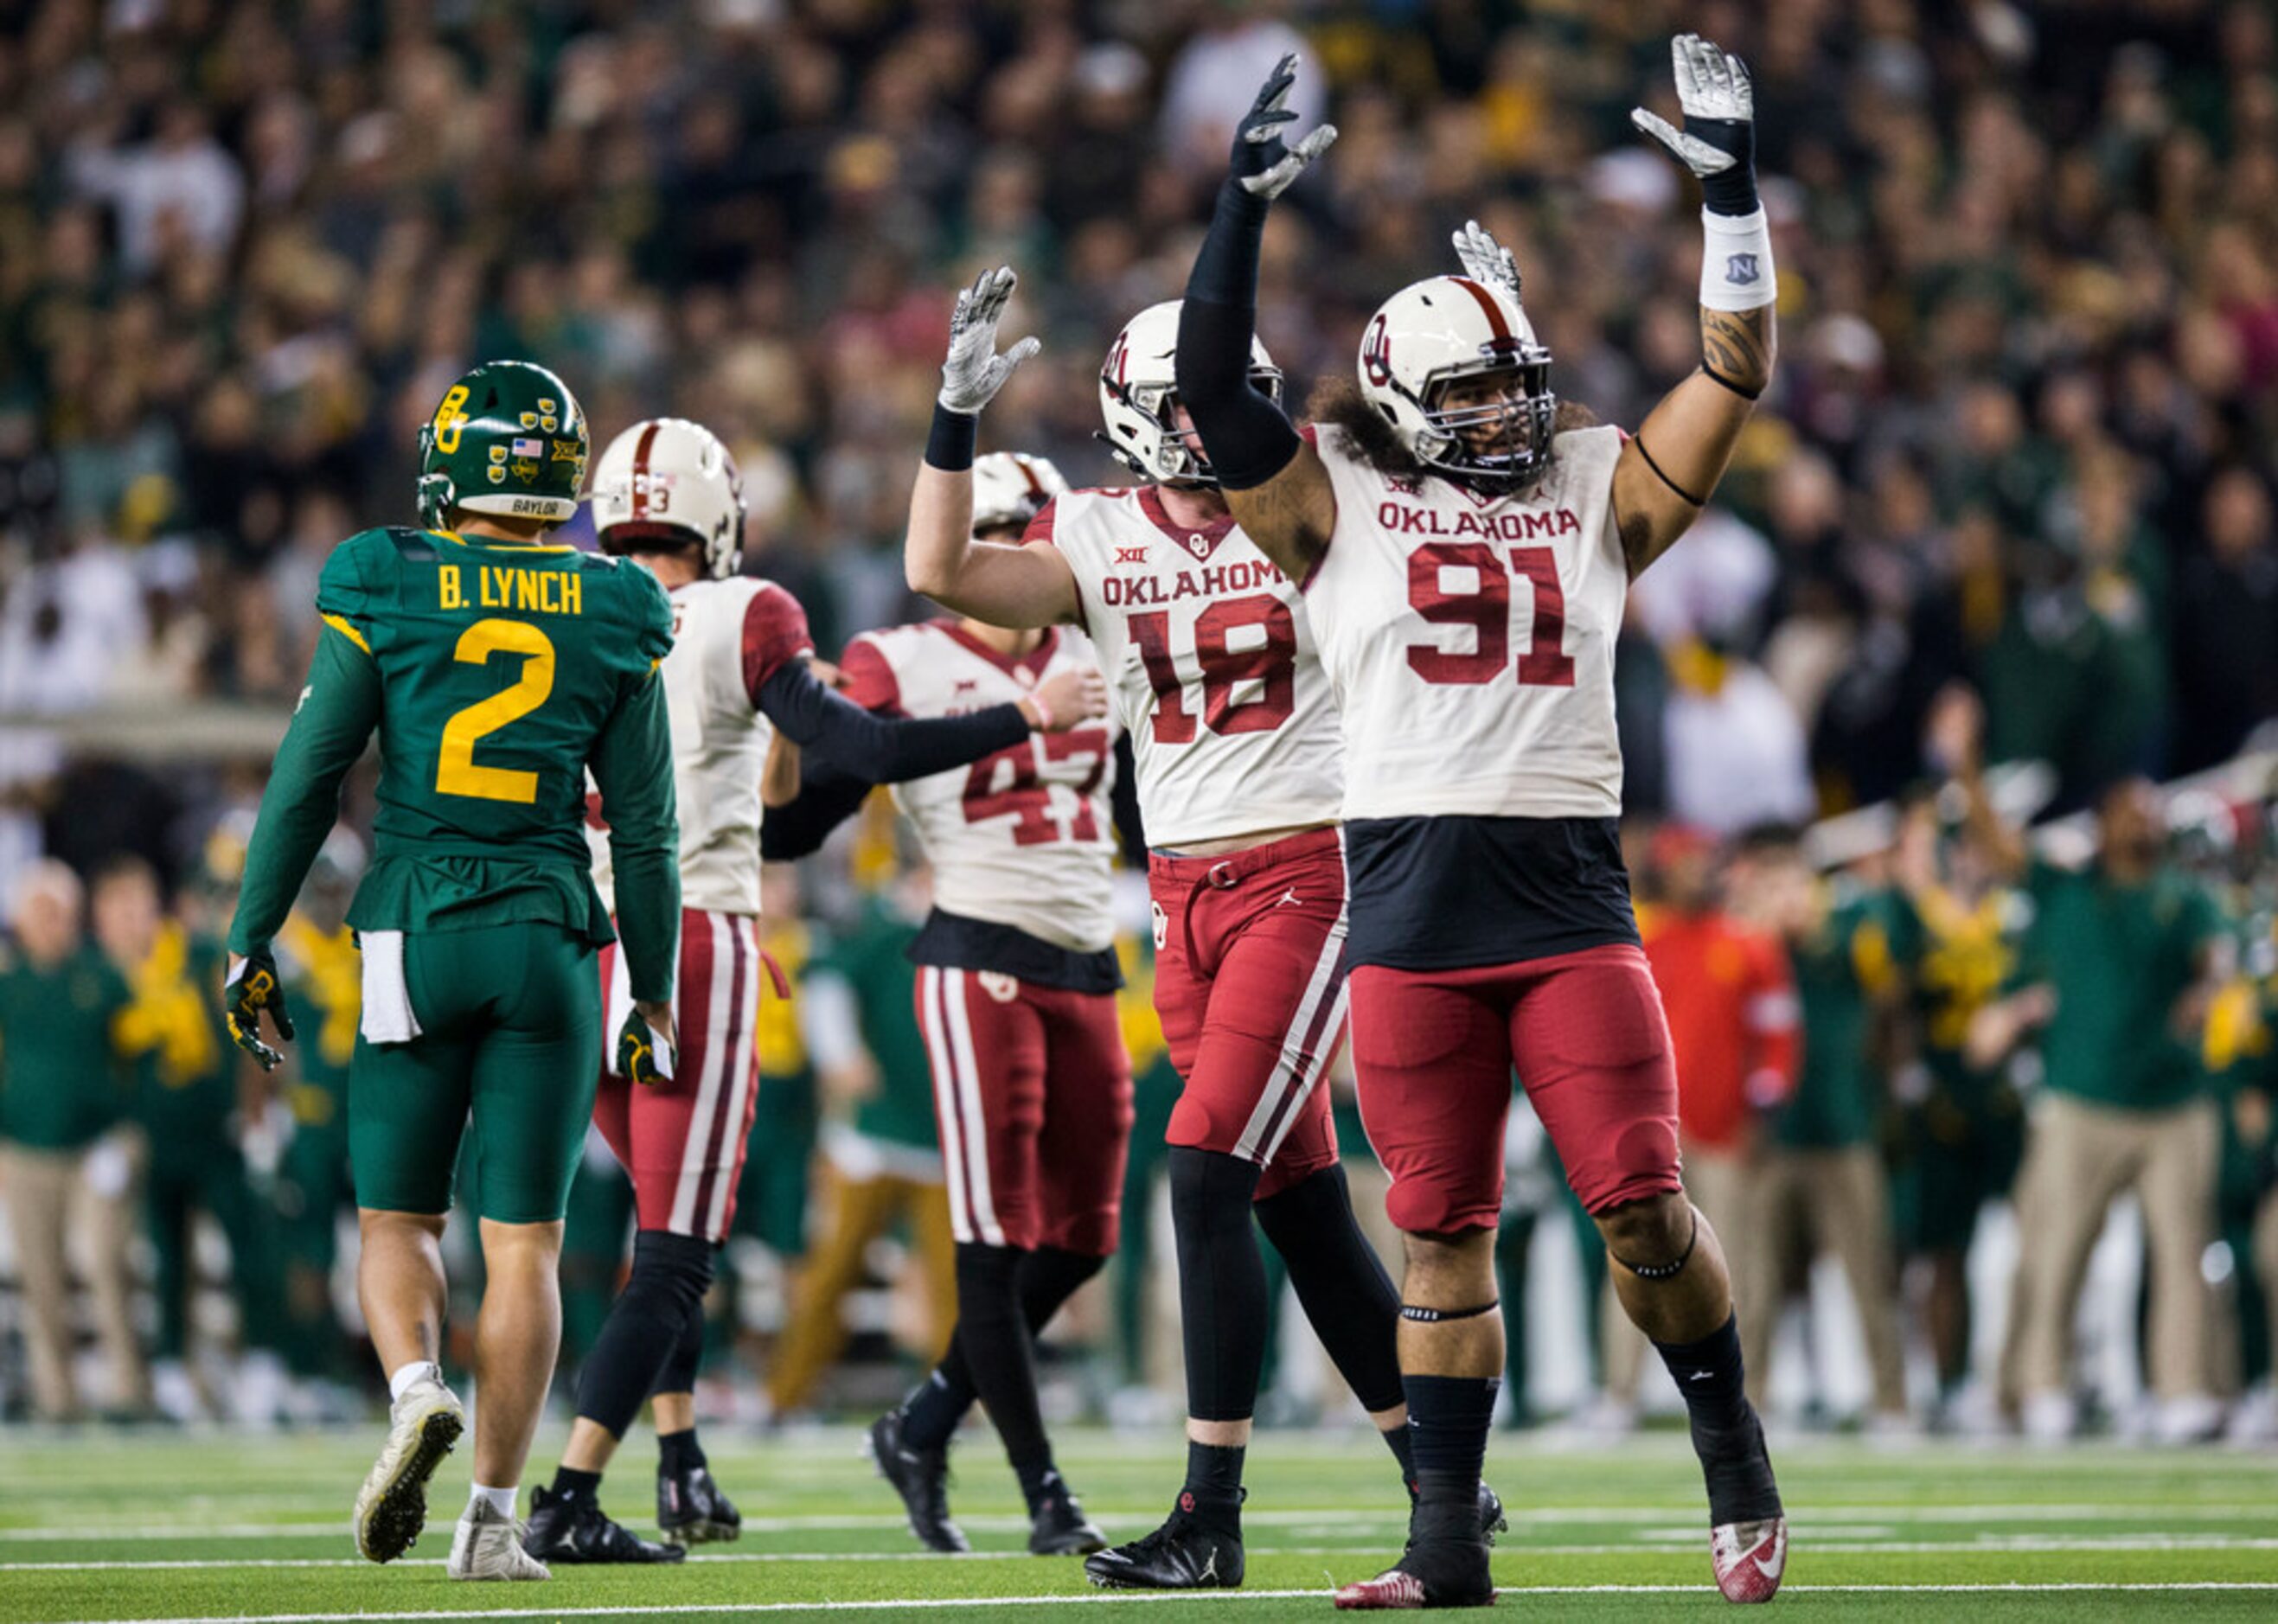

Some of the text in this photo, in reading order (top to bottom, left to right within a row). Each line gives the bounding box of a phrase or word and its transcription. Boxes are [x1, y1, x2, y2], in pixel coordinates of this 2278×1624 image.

[512, 499, 559, 515] BAYLOR
[652, 489, 670, 513] 3
[1379, 502, 1582, 541] OKLAHOMA
[438, 565, 582, 615] B. LYNCH
[1104, 559, 1289, 605] OKLAHOM
[1407, 542, 1575, 687] 91
[1127, 593, 1296, 744] 18
[435, 617, 556, 804] 2
[962, 729, 1108, 846] 47
